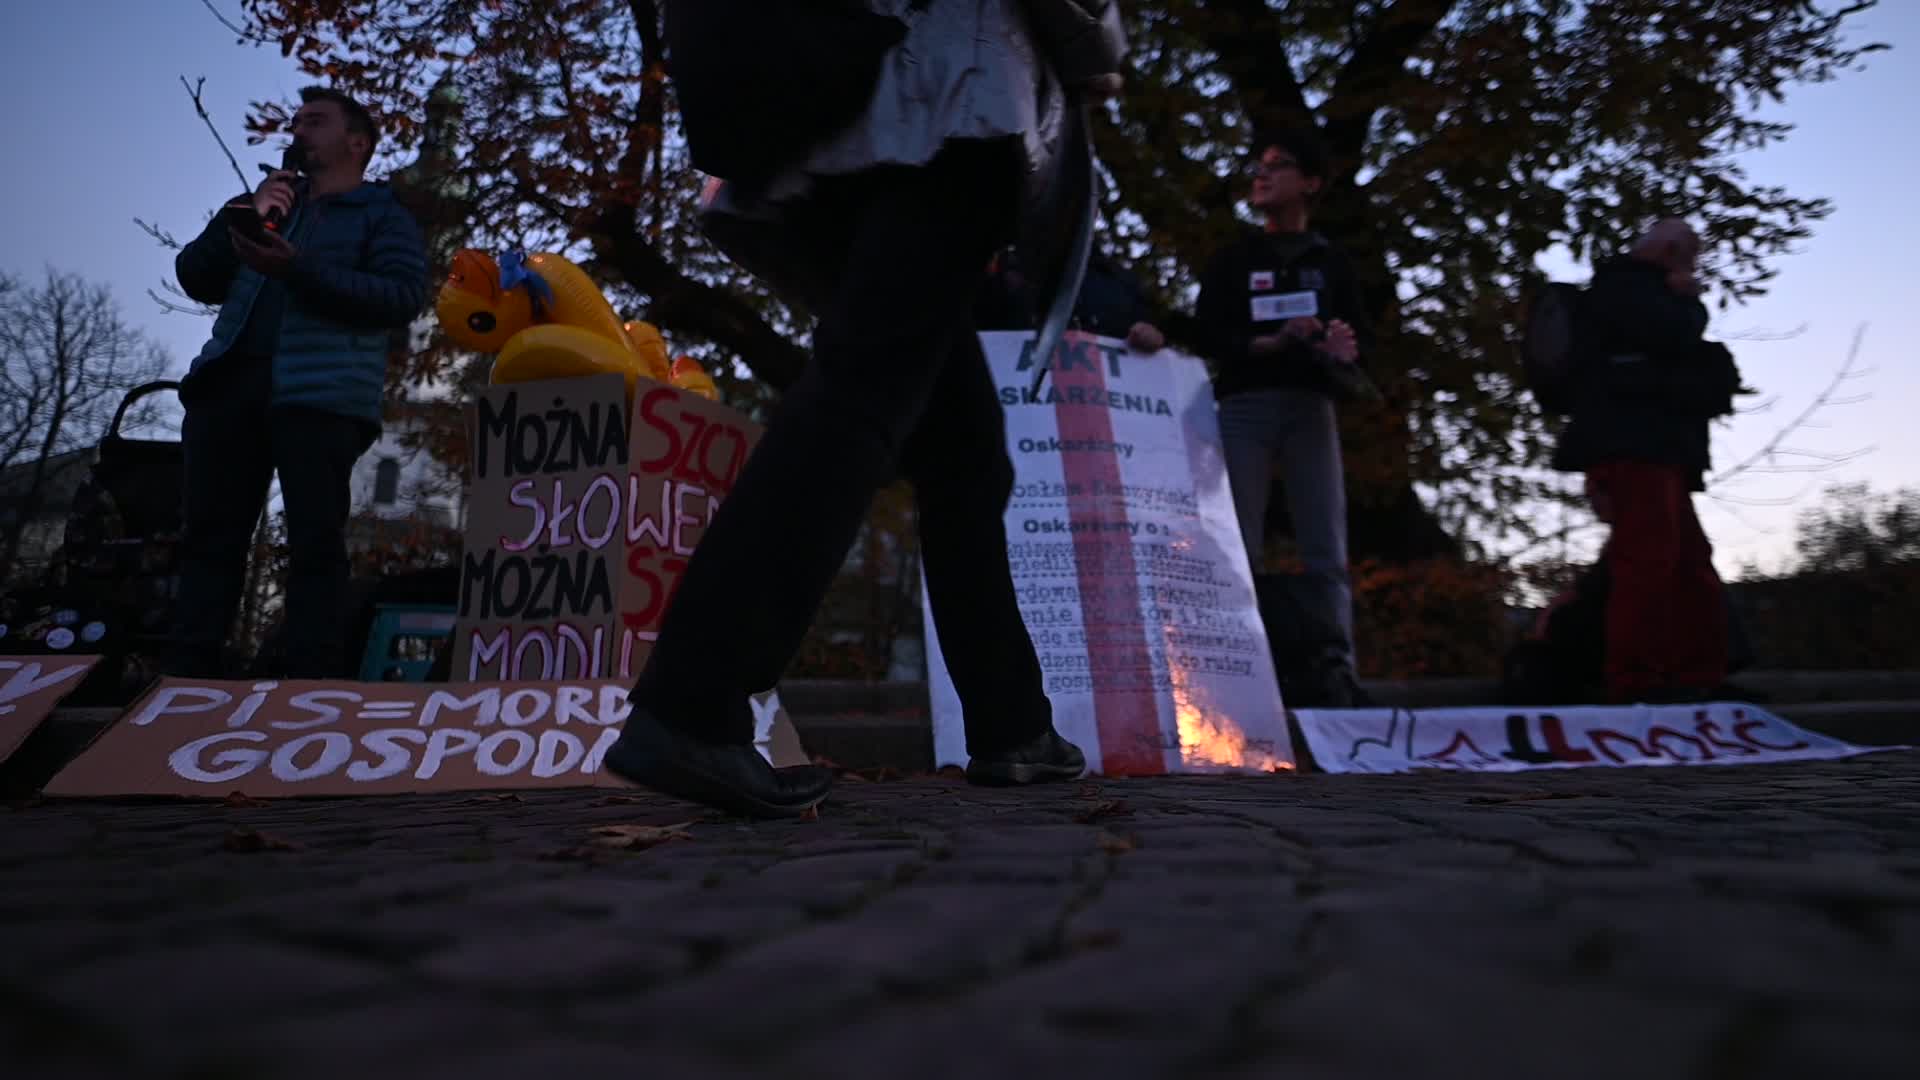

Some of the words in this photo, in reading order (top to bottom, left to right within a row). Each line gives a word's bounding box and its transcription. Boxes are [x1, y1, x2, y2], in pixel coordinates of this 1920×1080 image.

[476, 390, 629, 478] MOŻNA
[1000, 385, 1174, 418] SKARŻENIA
[501, 474, 721, 557] SŁOWE
[460, 545, 614, 620] MOŻNA
[168, 729, 622, 782] GOSPOD
